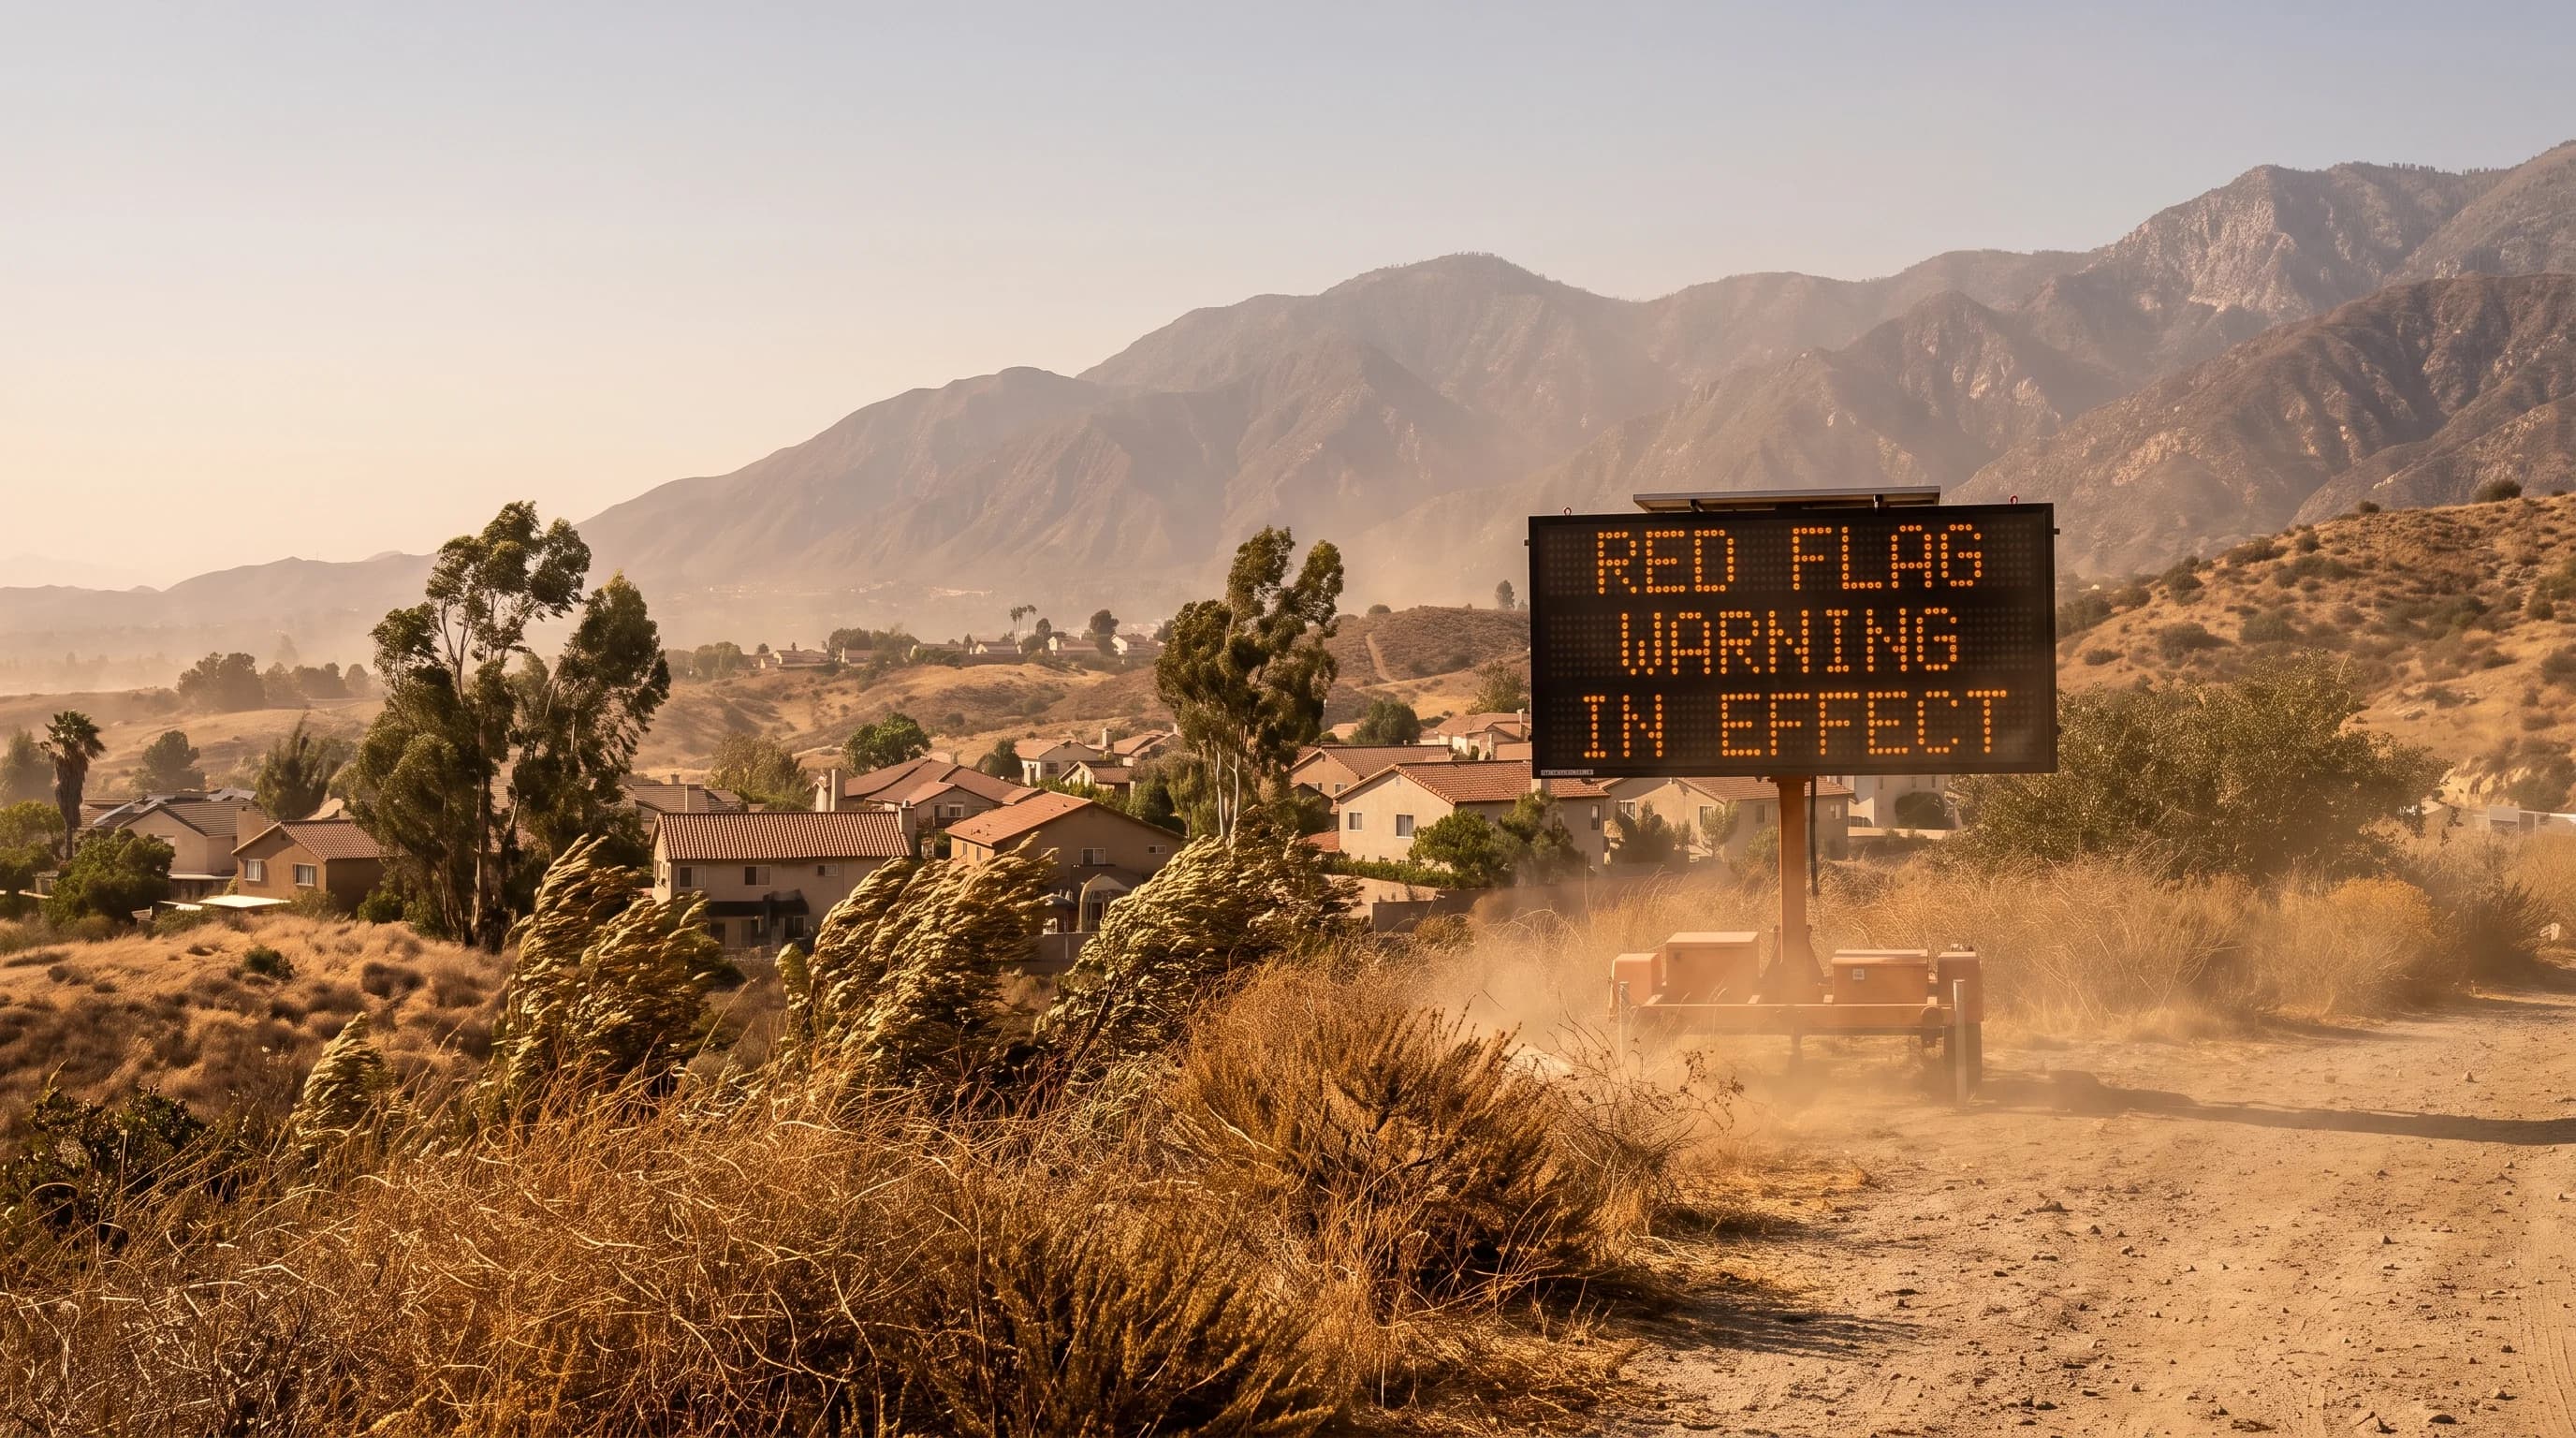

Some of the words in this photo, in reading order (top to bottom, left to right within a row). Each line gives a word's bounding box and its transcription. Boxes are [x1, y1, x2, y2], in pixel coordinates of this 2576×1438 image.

[1598, 530, 1734, 594] RED
[1793, 524, 1982, 591] FLAG
[1622, 609, 1957, 675] WARNING
[1584, 695, 1663, 758] IN
[1721, 690, 2007, 756] EFFECT
